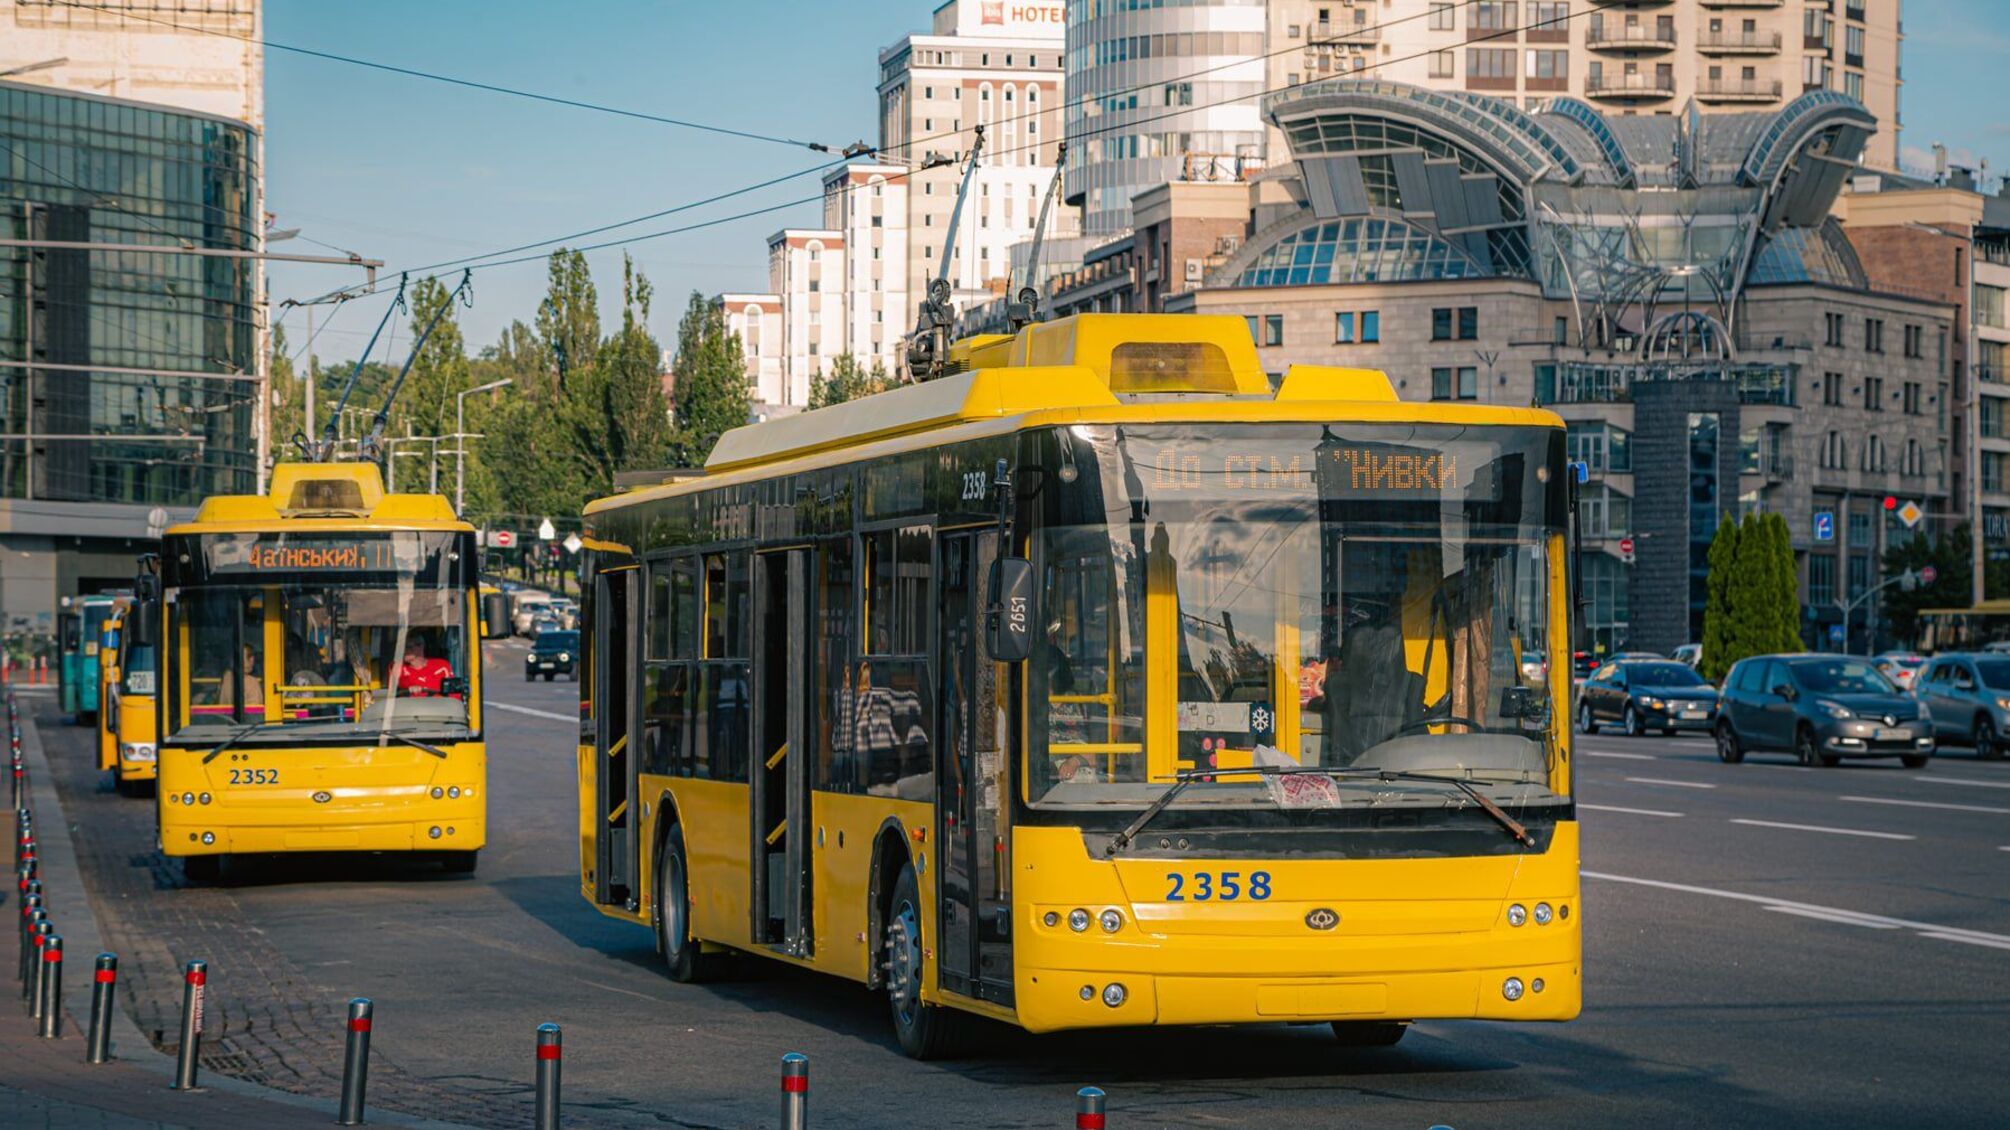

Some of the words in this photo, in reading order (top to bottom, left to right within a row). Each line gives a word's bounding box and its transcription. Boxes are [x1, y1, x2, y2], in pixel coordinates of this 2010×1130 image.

[1151, 448, 1200, 489] До
[962, 471, 986, 500] 2358
[1010, 597, 1026, 633] 2651
[229, 769, 279, 785] 2352
[1166, 871, 1272, 901] 2358
